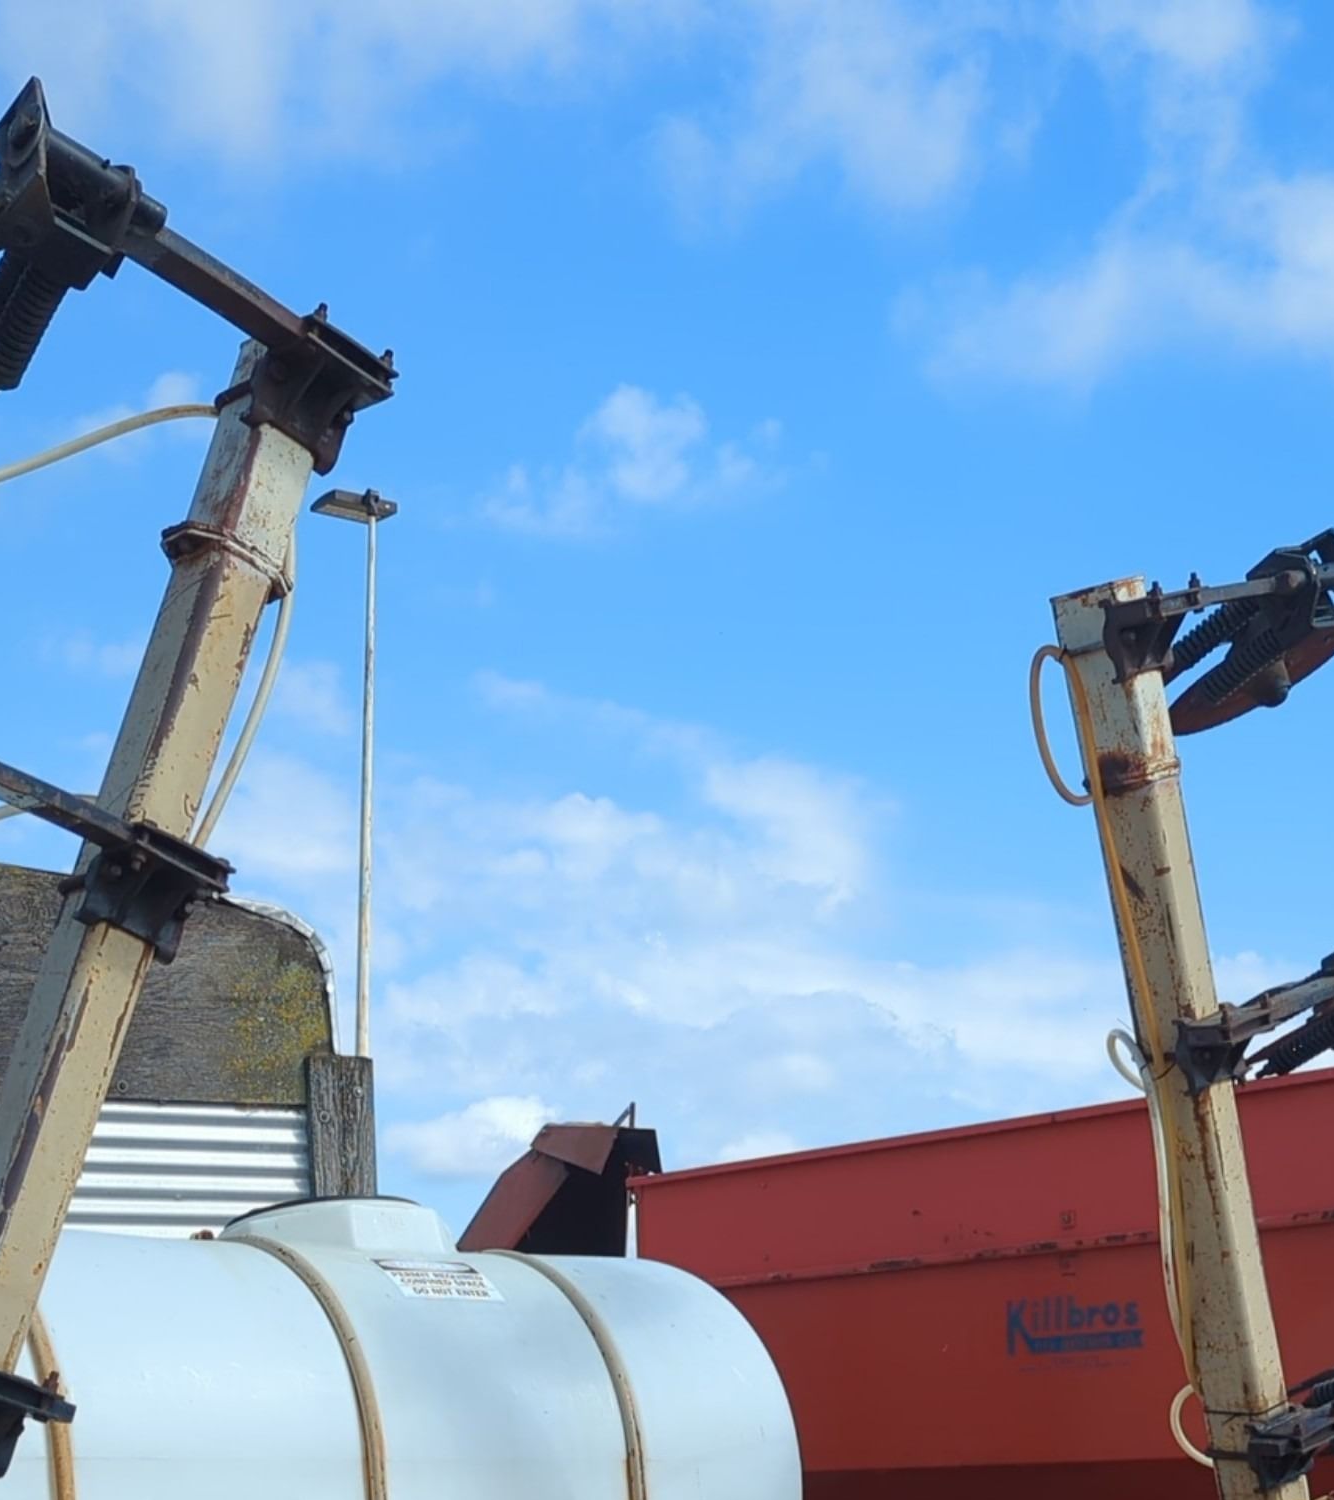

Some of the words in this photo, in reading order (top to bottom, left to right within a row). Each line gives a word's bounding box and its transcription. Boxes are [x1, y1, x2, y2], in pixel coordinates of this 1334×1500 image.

[454, 1280, 486, 1288] SPACE
[412, 1287, 430, 1295] DO
[431, 1287, 453, 1296] NOT
[455, 1288, 491, 1297] ENTER
[1005, 1296, 1139, 1356] Killbros
